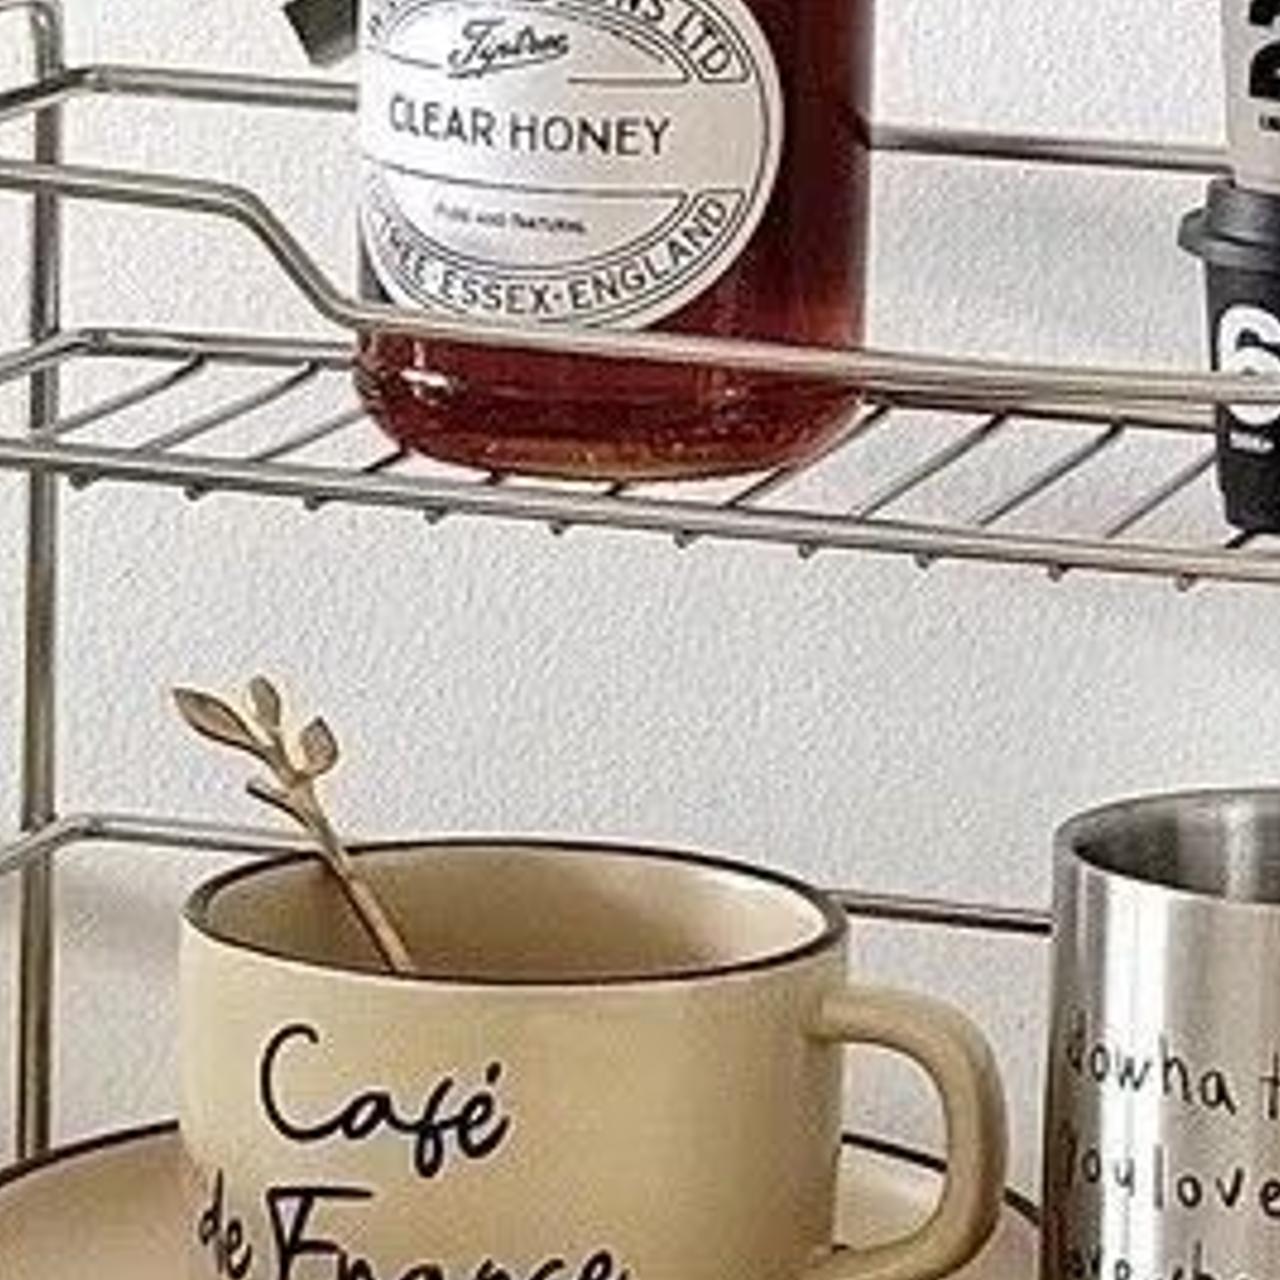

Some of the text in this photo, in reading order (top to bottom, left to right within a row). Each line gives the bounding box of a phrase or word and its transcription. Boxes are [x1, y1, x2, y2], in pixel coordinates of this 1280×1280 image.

[673, 8, 733, 74] LTD
[388, 92, 672, 157] CLEAR HONEY
[568, 197, 727, 310] ENGLAND
[260, 1023, 510, 1178] Café
